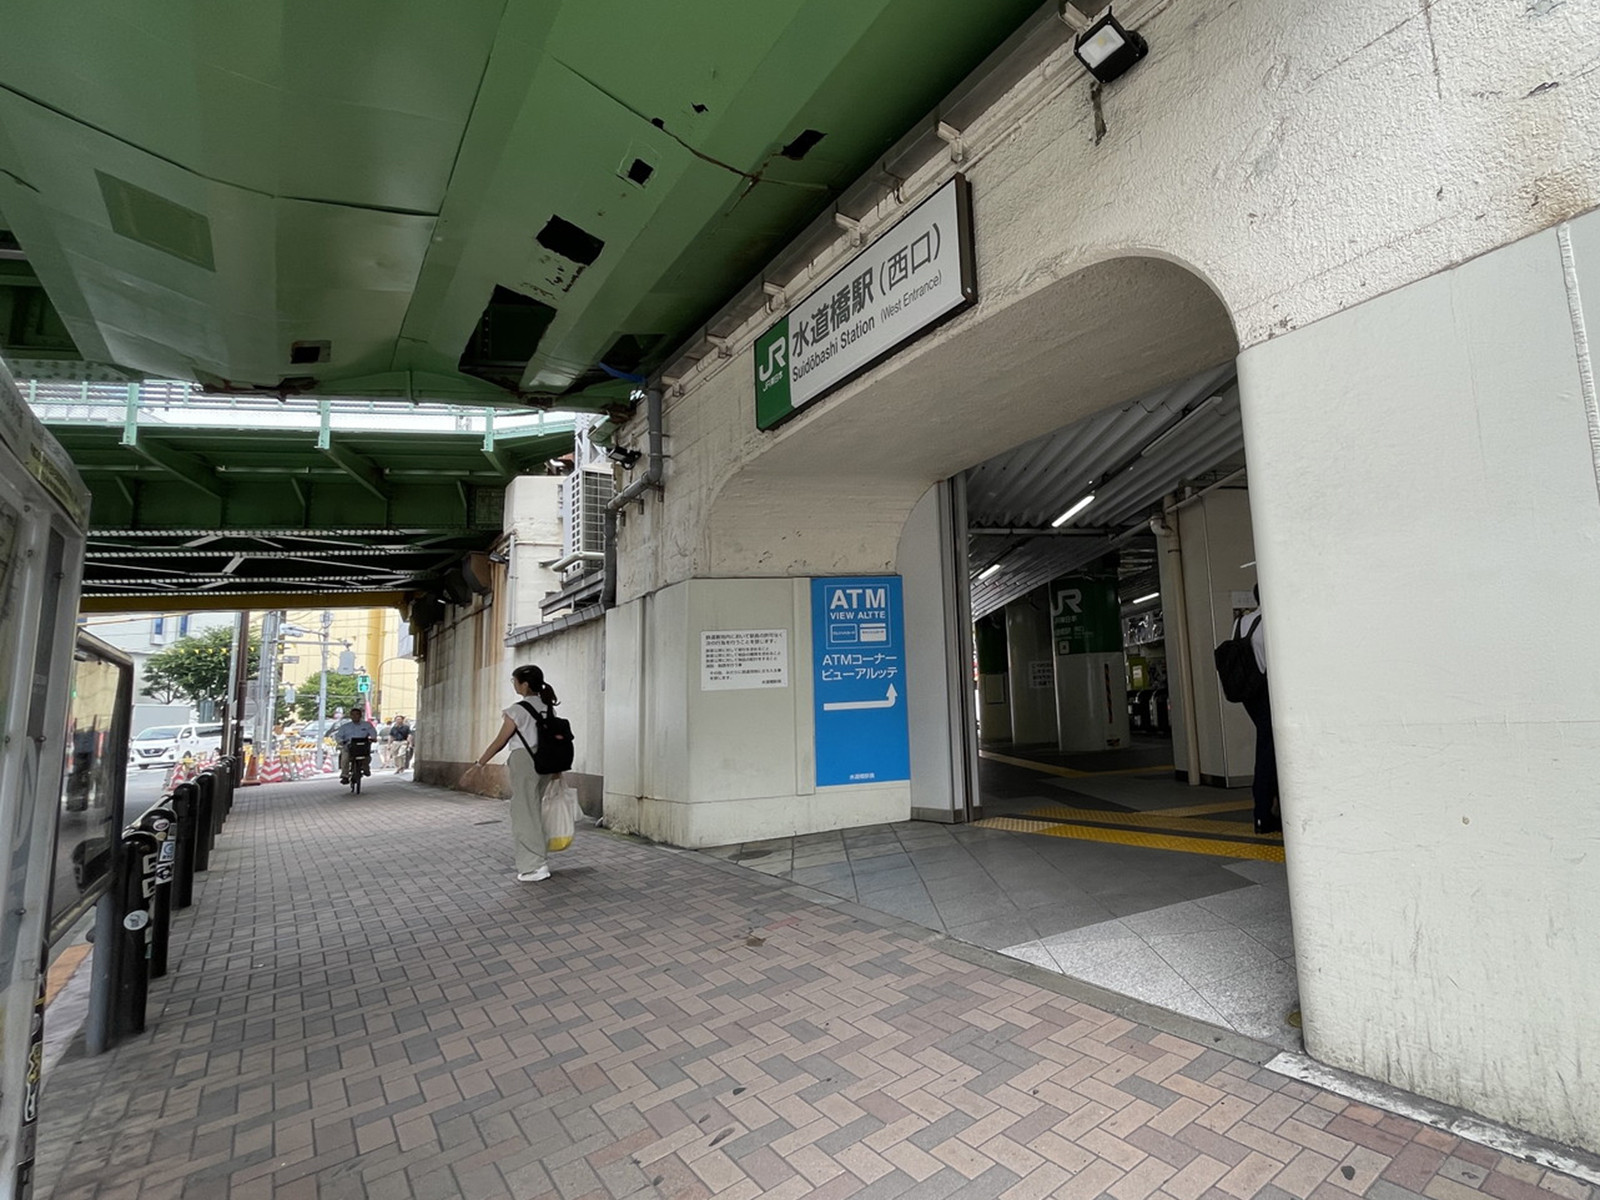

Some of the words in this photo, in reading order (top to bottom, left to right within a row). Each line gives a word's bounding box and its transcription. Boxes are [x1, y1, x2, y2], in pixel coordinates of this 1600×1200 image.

[792, 339, 839, 382] Suidōbashi
[841, 316, 875, 350] Station
[880, 302, 902, 323] (West
[903, 269, 942, 307] Entrance)
[759, 336, 787, 382] JR
[830, 588, 886, 609] ATM
[1050, 588, 1083, 616] JR
[830, 611, 855, 620] VIEW
[857, 611, 886, 619] ALTTE
[822, 653, 897, 666] ATMコーナー
[822, 666, 898, 681] ビューアルッテ
